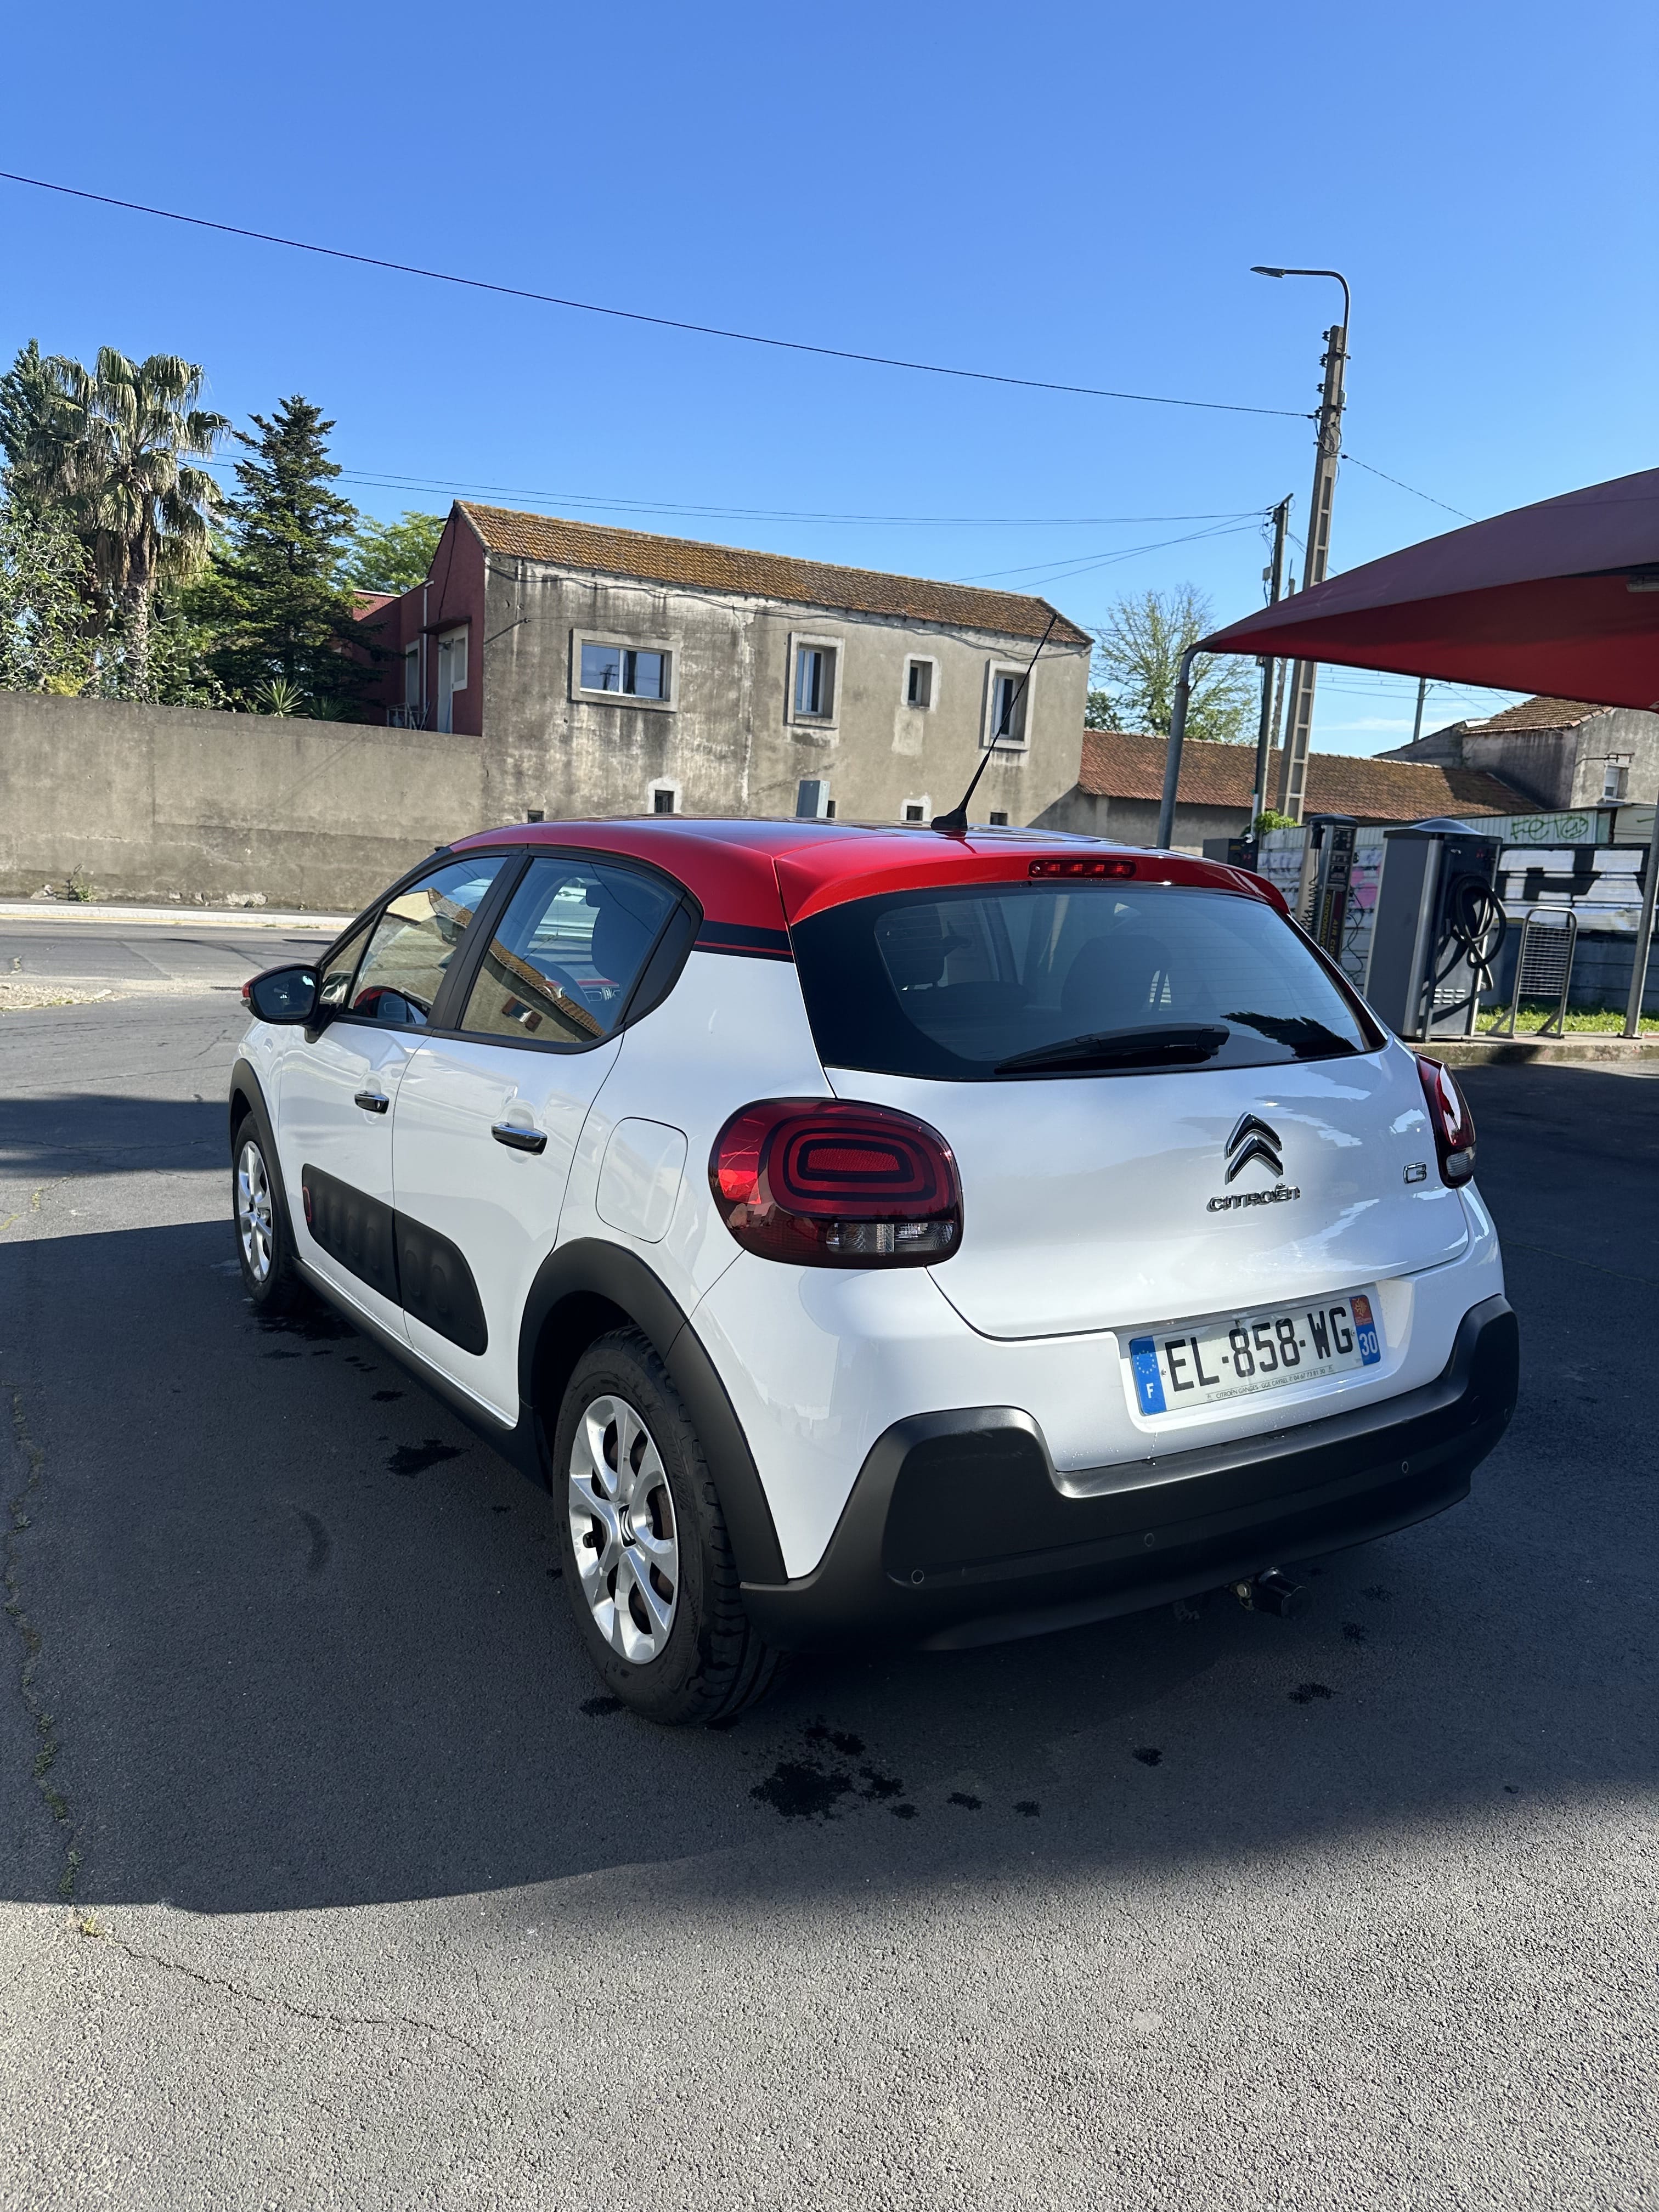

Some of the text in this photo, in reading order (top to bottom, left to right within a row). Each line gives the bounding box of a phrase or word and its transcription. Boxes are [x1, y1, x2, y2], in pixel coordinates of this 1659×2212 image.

[1330, 918, 1339, 936] AIR
[1403, 1162, 1426, 1184] C3
[1207, 1183, 1300, 1211] CITROËN
[1359, 1331, 1378, 1356] 30
[1146, 1383, 1154, 1398] F
